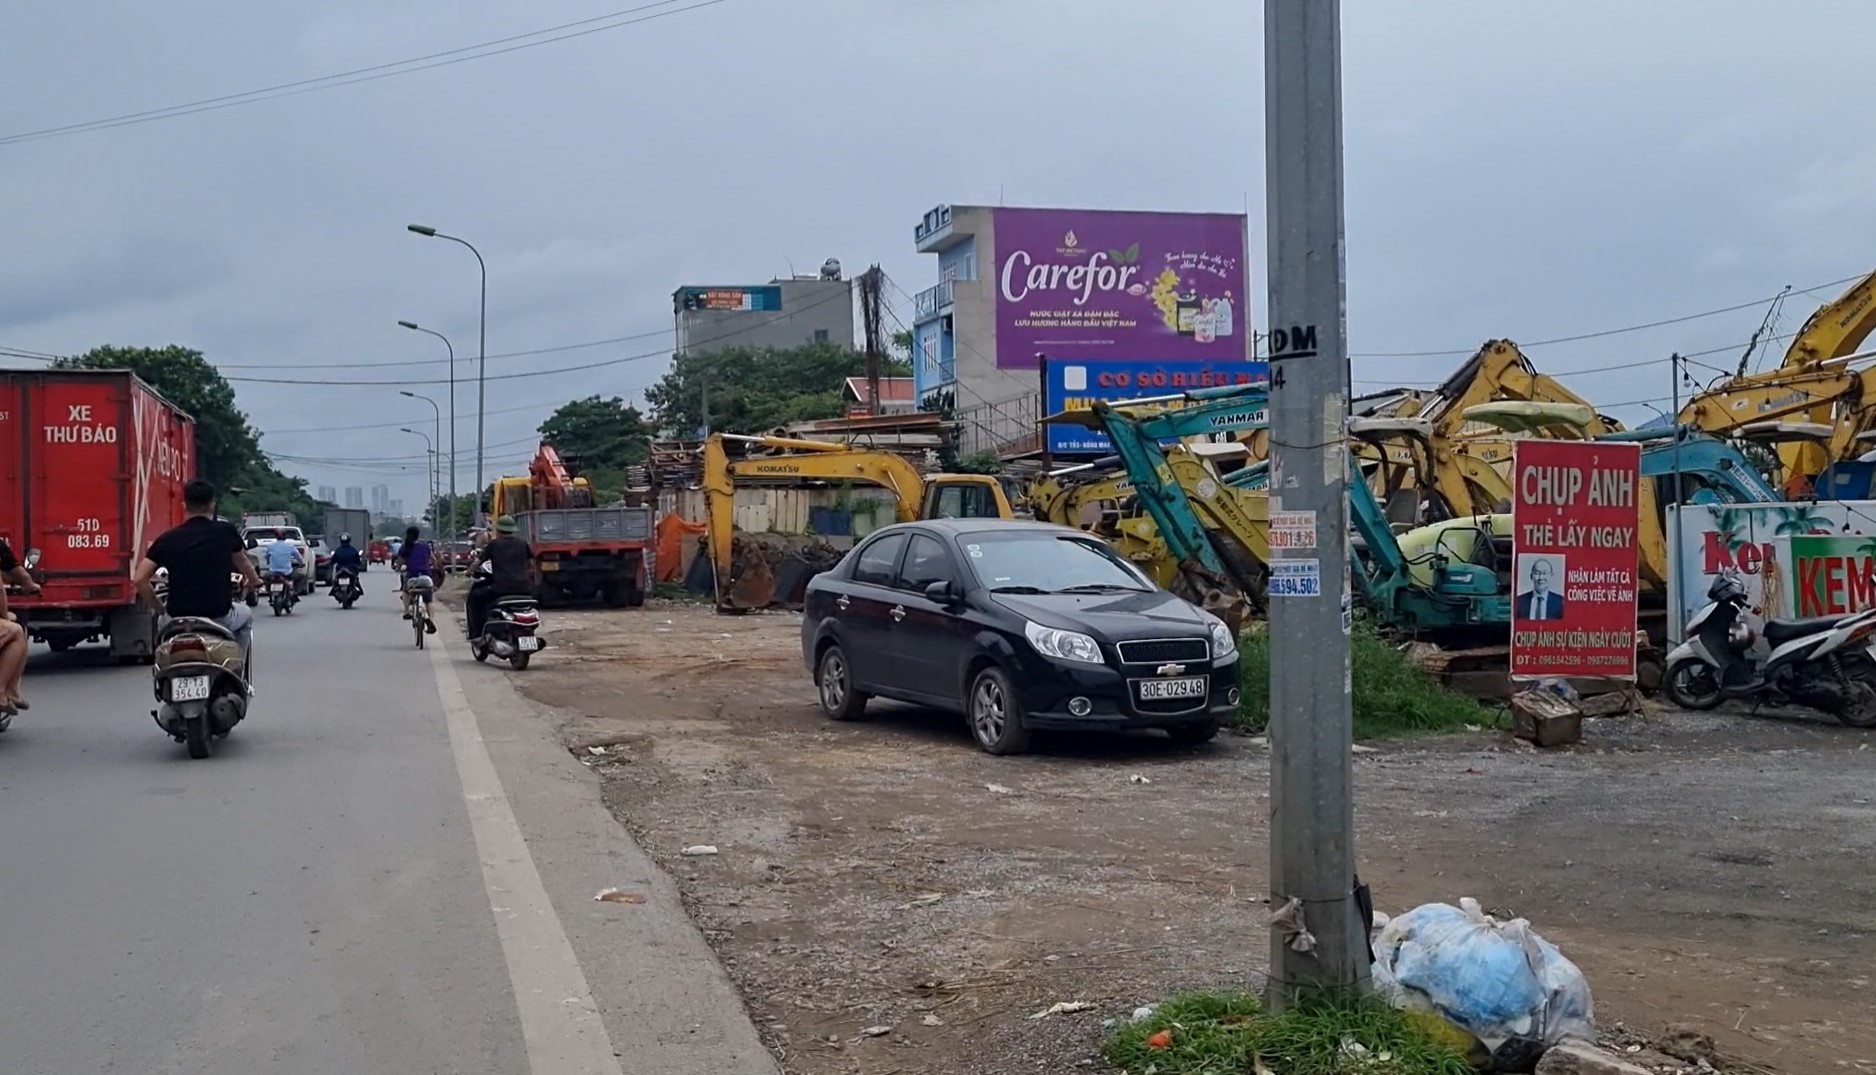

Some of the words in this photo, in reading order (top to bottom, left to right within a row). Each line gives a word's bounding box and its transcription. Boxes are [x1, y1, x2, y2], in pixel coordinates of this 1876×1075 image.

[1001, 250, 1137, 305] Carefor
[68, 405, 92, 421] XE
[1210, 411, 1264, 427] YANMAR
[43, 425, 78, 443] THƯ
[81, 423, 117, 443] BÁO
[756, 464, 800, 473] KOMATSU
[1522, 465, 1583, 516] CHỤP
[1587, 455, 1634, 508] ẢNH
[77, 518, 100, 532] 51D
[1523, 517, 1553, 547] THẺ
[1557, 518, 1587, 548] LẤY
[1590, 526, 1634, 548] NGAY
[67, 535, 110, 548] 083.69
[1567, 566, 1589, 586] NHẬN
[1606, 567, 1619, 584] TẤT
[1567, 585, 1588, 602] CÔNG
[1589, 585, 1606, 604] VIỆC
[1798, 555, 1876, 618] KEM
[1515, 632, 1537, 651] CHỤP
[1537, 626, 1555, 648] ẢNH
[1556, 629, 1567, 652] SỰ
[1568, 626, 1588, 652] KIỆN
[1516, 655, 1530, 665] ĐT
